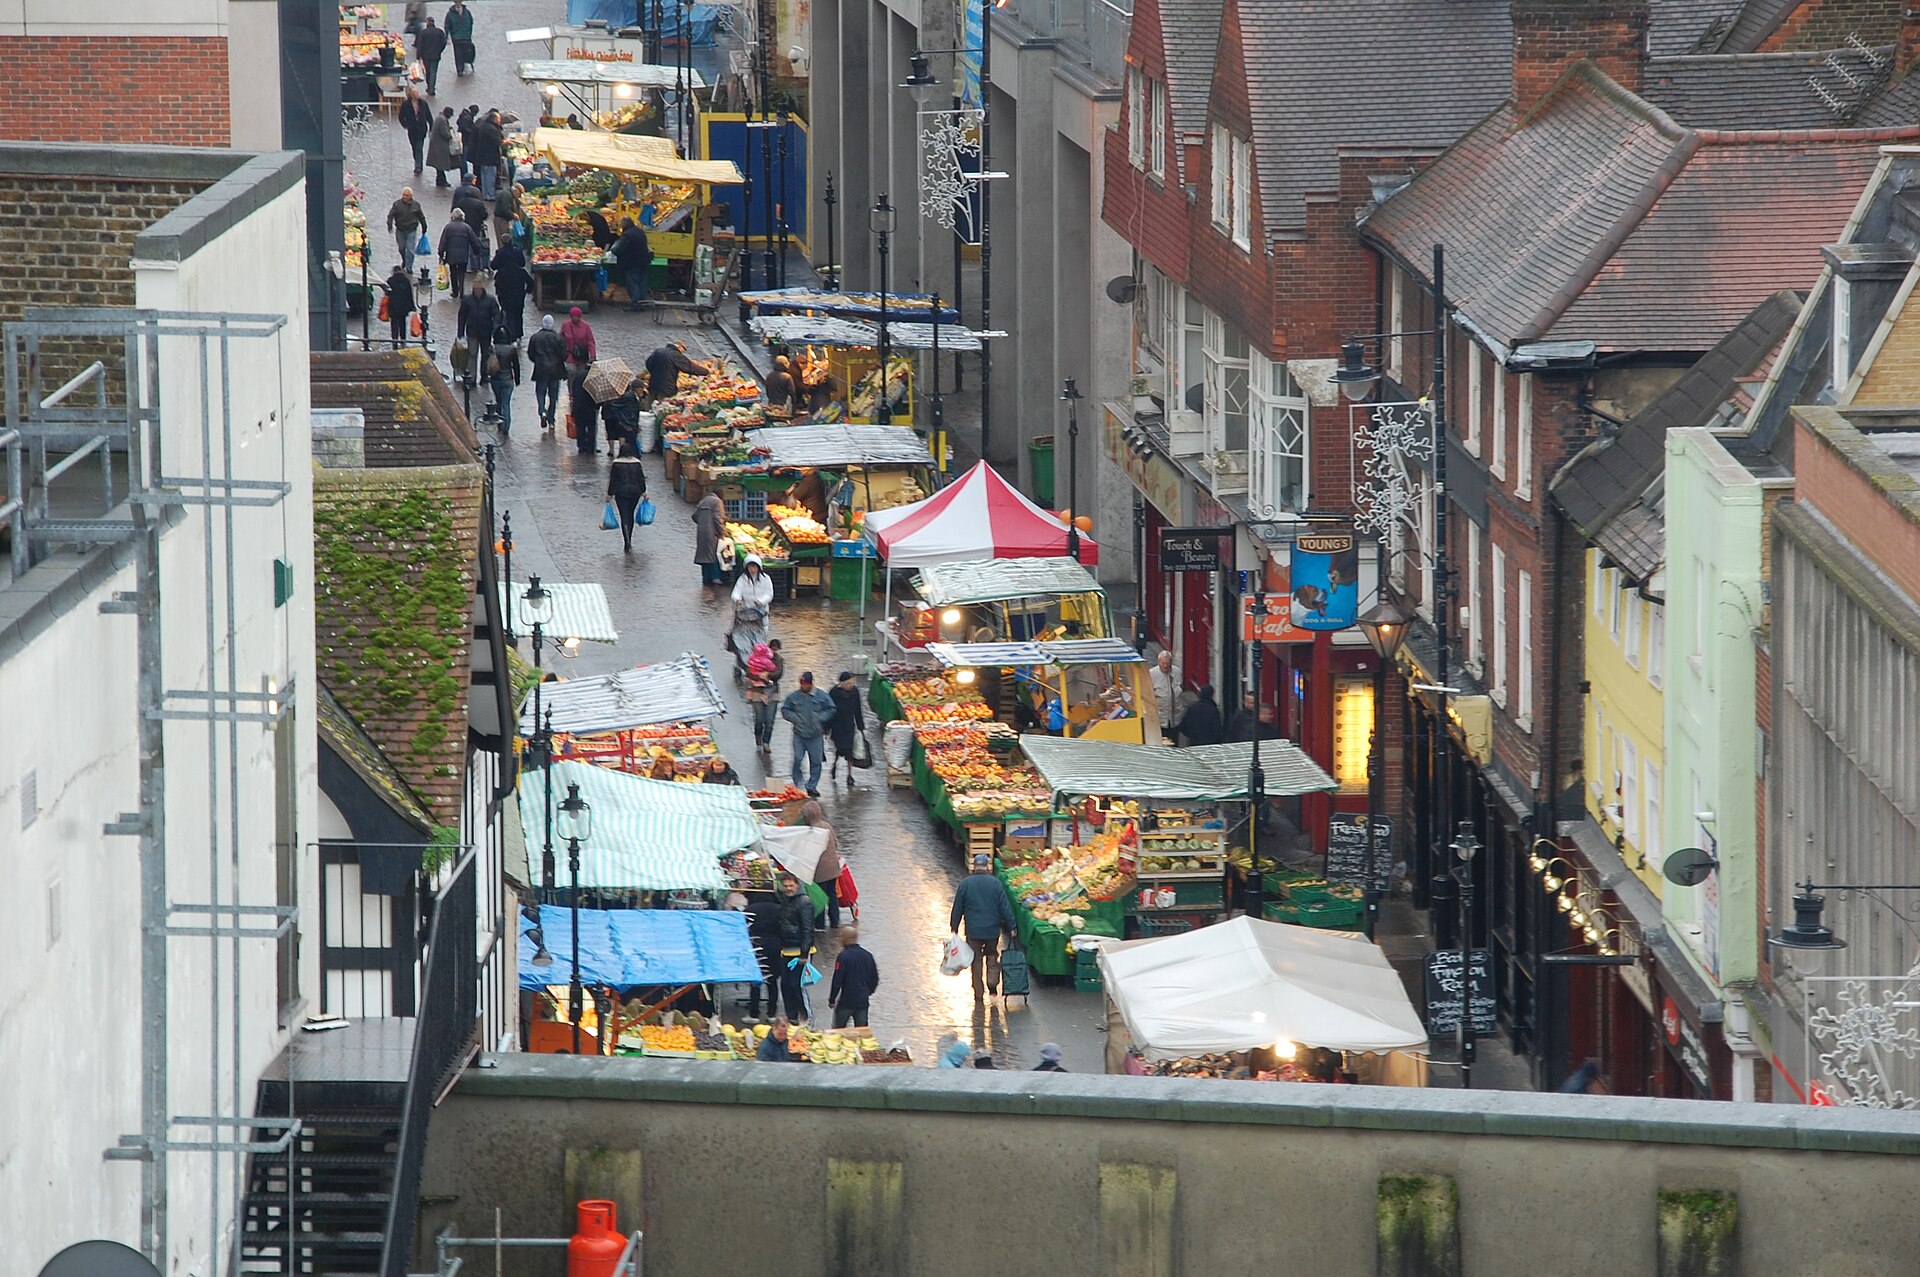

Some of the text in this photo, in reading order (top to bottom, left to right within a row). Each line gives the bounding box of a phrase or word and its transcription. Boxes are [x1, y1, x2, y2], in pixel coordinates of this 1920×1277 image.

[1163, 538, 1203, 550] Touch &
[1300, 538, 1348, 550] YOUNG'S
[1180, 550, 1216, 564] Beauty
